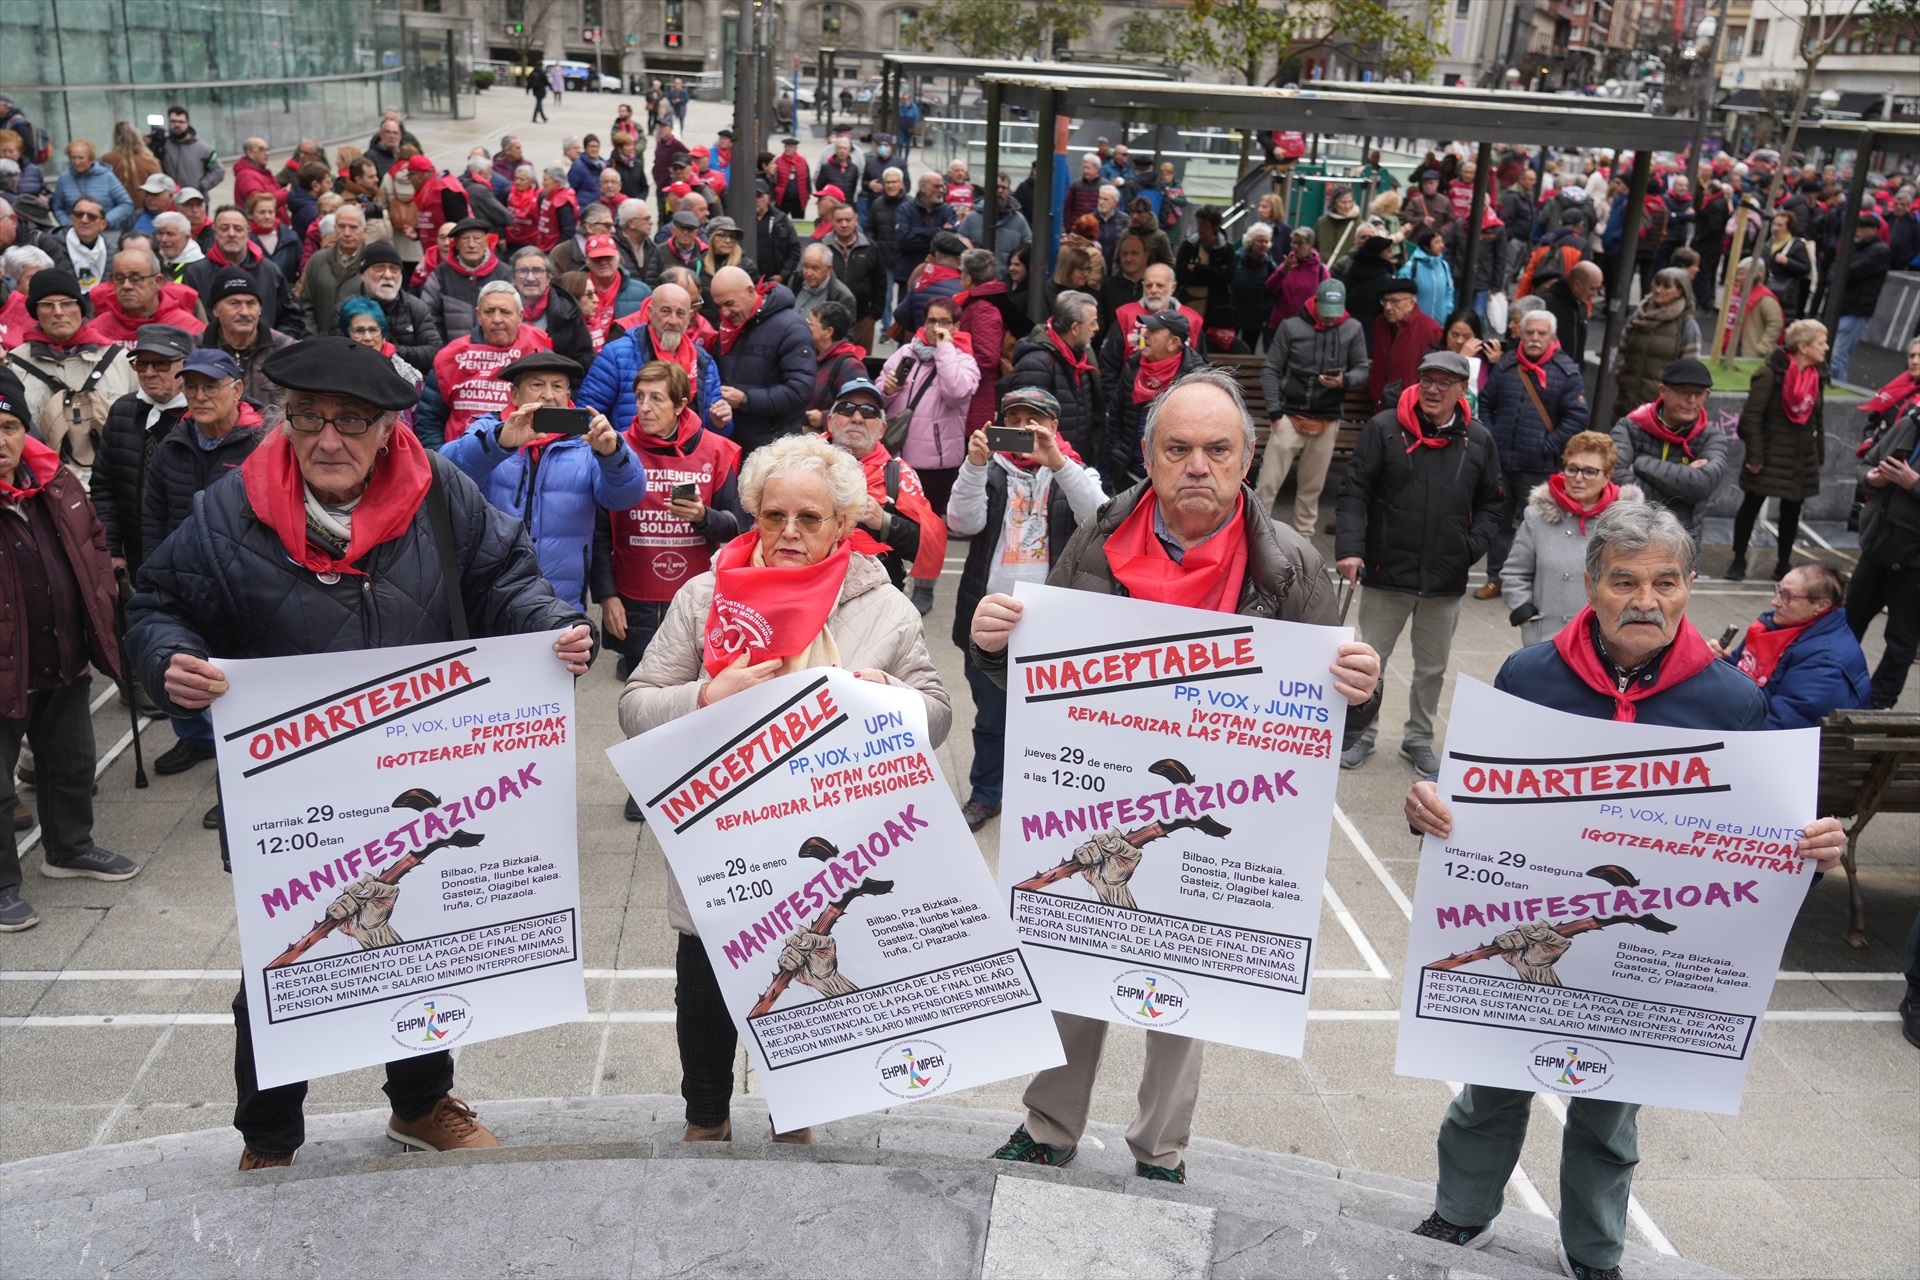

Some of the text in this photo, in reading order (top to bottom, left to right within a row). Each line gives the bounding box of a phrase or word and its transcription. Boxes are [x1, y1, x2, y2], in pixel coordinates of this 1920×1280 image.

[460, 389, 508, 401] SOLDATA
[739, 611, 771, 646] MOBIMENDUA
[754, 613, 774, 636] BIZKAIA
[1025, 638, 1254, 694] INACEPTABLE
[1175, 685, 1328, 722] PP, VOX y JUNTS
[1279, 680, 1322, 700] UPN
[249, 659, 473, 761] ONARTEZINA
[386, 703, 560, 737] PP, VOX, UPN eta JUNTS
[865, 710, 903, 734] UPN
[1192, 708, 1332, 744] ¡VOTAN CONTRA
[471, 715, 566, 741] PENTSIOAK
[1068, 706, 1331, 759] REVALORIZAR LAS PENSIONES!
[377, 730, 566, 769] IGOTZEAREN KONTRA!
[661, 688, 839, 824] INACEPTABLE
[789, 732, 915, 775] PP, VOX y JUNTS
[1024, 747, 1132, 772] jueves 29 de enero
[811, 752, 928, 793] ¡VOTAN CONTRA
[1033, 773, 1046, 782] las
[1052, 770, 1105, 792] 12:00
[1463, 757, 1711, 796] ONARTEZINA
[715, 767, 935, 831] REVALORIZAR LAS PENSIONES!
[1021, 769, 1298, 842] MANIFESTAZIOAK
[253, 805, 389, 831] urtarrilak 29 osteguna
[1600, 804, 1804, 842] PP, VOX, UPN eta JUNTS
[261, 762, 542, 918] MANIFESTAZIOAK
[1582, 828, 1804, 875] IGOTZEAREN KONTRA!
[441, 855, 541, 878] Bilbao, Pza Bizkaia.
[442, 863, 556, 889] Donostia, Ilunbe kalea.
[697, 858, 787, 886] jueves 29 de enero
[1182, 863, 1299, 889] Donostia, Ilunbe kalea.
[1183, 851, 1285, 875] Bilbao, Pza Bizkaia.
[1445, 846, 1583, 878] urtarrilak 29 osteguna
[443, 873, 561, 900] Gasteiz, Olagibel kalea.
[443, 889, 536, 911] Iruña, C/ Plazaola.
[713, 898, 726, 906] las
[727, 879, 773, 902] 12:00
[723, 804, 929, 969] MANIFESTAZIOAK
[1180, 886, 1274, 908] Iruña, C/ Plazaola.
[1181, 875, 1303, 901] Gasteiz, Olagibel kalea.
[866, 897, 961, 926] Bilbao, Pza Bizkaia.
[872, 903, 981, 937] Donostia, Ilunbe kalea.
[1436, 880, 1759, 929] MANIFESTAZIOAK
[271, 914, 566, 979] -REVALORIZACIÓN AUTOMÁTICA DE LAS PENSIONES
[878, 913, 990, 947] Gasteiz, Olagibel kalea.
[883, 930, 970, 958] Iruña, C/ Plazaola.
[272, 926, 561, 990] -RESTABLECIMIENTO DE LA PAGA DE FINAL DE AÑO
[273, 936, 563, 1002] -MEJORA SUSTANCIAL DE LAS PENSIONES MINIMAS
[275, 995, 332, 1013] -PENSION
[336, 986, 379, 1001] MINIMA
[392, 974, 435, 989] SALARIO
[438, 966, 473, 980] MINIMO
[476, 946, 570, 974] INTERPROFESIONAL
[1117, 985, 1182, 1008] EHPM MPEH
[396, 1007, 465, 1034] EHPM MPEH
[881, 1056, 944, 1080] EHPM MPEH
[1535, 1055, 1607, 1074] EHPM MPEH
